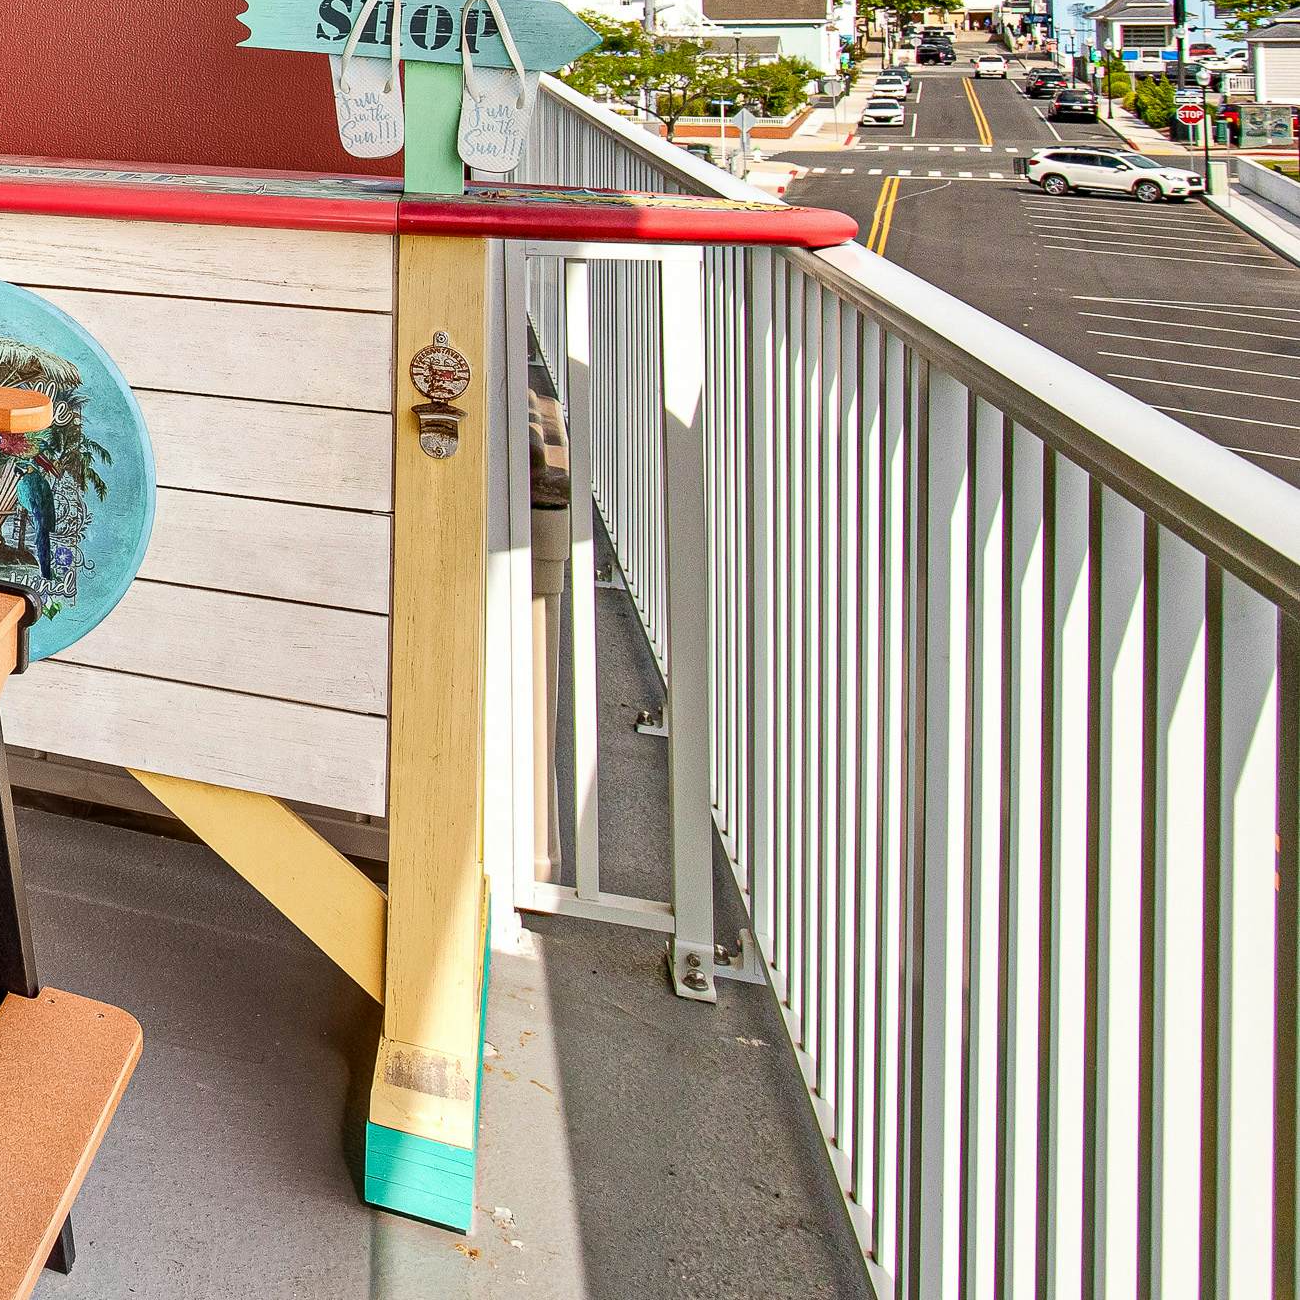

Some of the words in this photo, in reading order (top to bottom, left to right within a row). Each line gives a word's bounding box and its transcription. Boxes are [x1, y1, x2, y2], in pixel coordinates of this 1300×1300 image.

[336, 91, 380, 121] Fun
[468, 98, 514, 128] Fun
[1178, 110, 1203, 118] STOP
